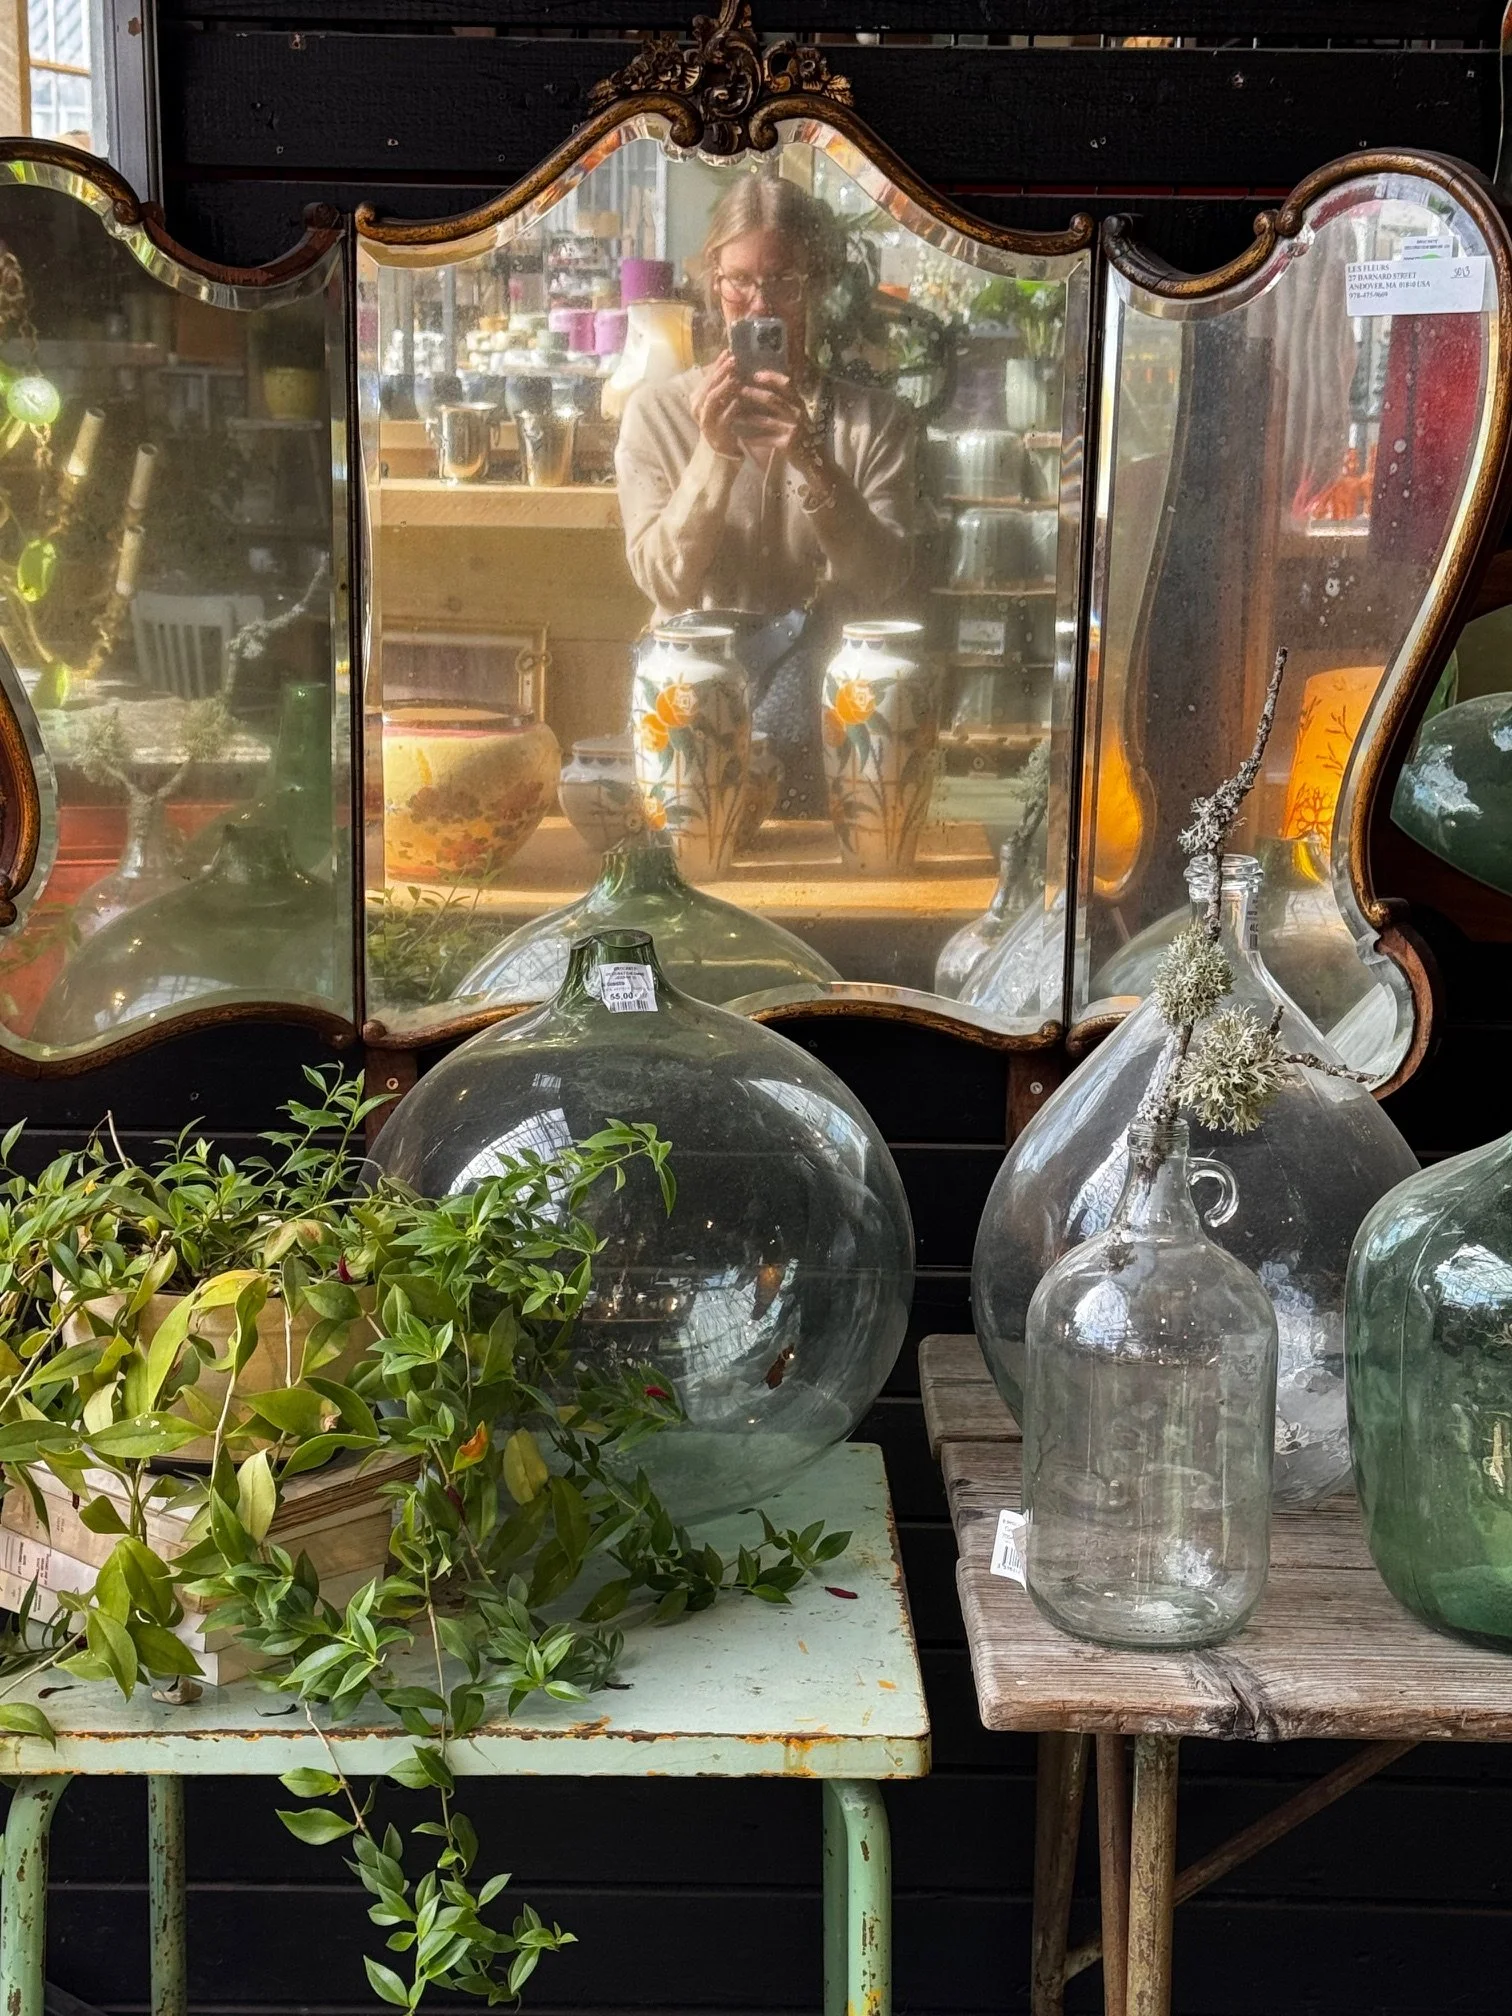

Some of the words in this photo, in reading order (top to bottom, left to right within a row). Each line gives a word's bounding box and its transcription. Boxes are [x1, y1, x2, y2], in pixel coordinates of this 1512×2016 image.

[1348, 265, 1362, 273] LES
[1363, 264, 1390, 272] FLEURS
[1348, 274, 1357, 282] 27
[1392, 272, 1417, 280] STREET
[1386, 281, 1397, 289] MA
[1417, 280, 1431, 288] USA
